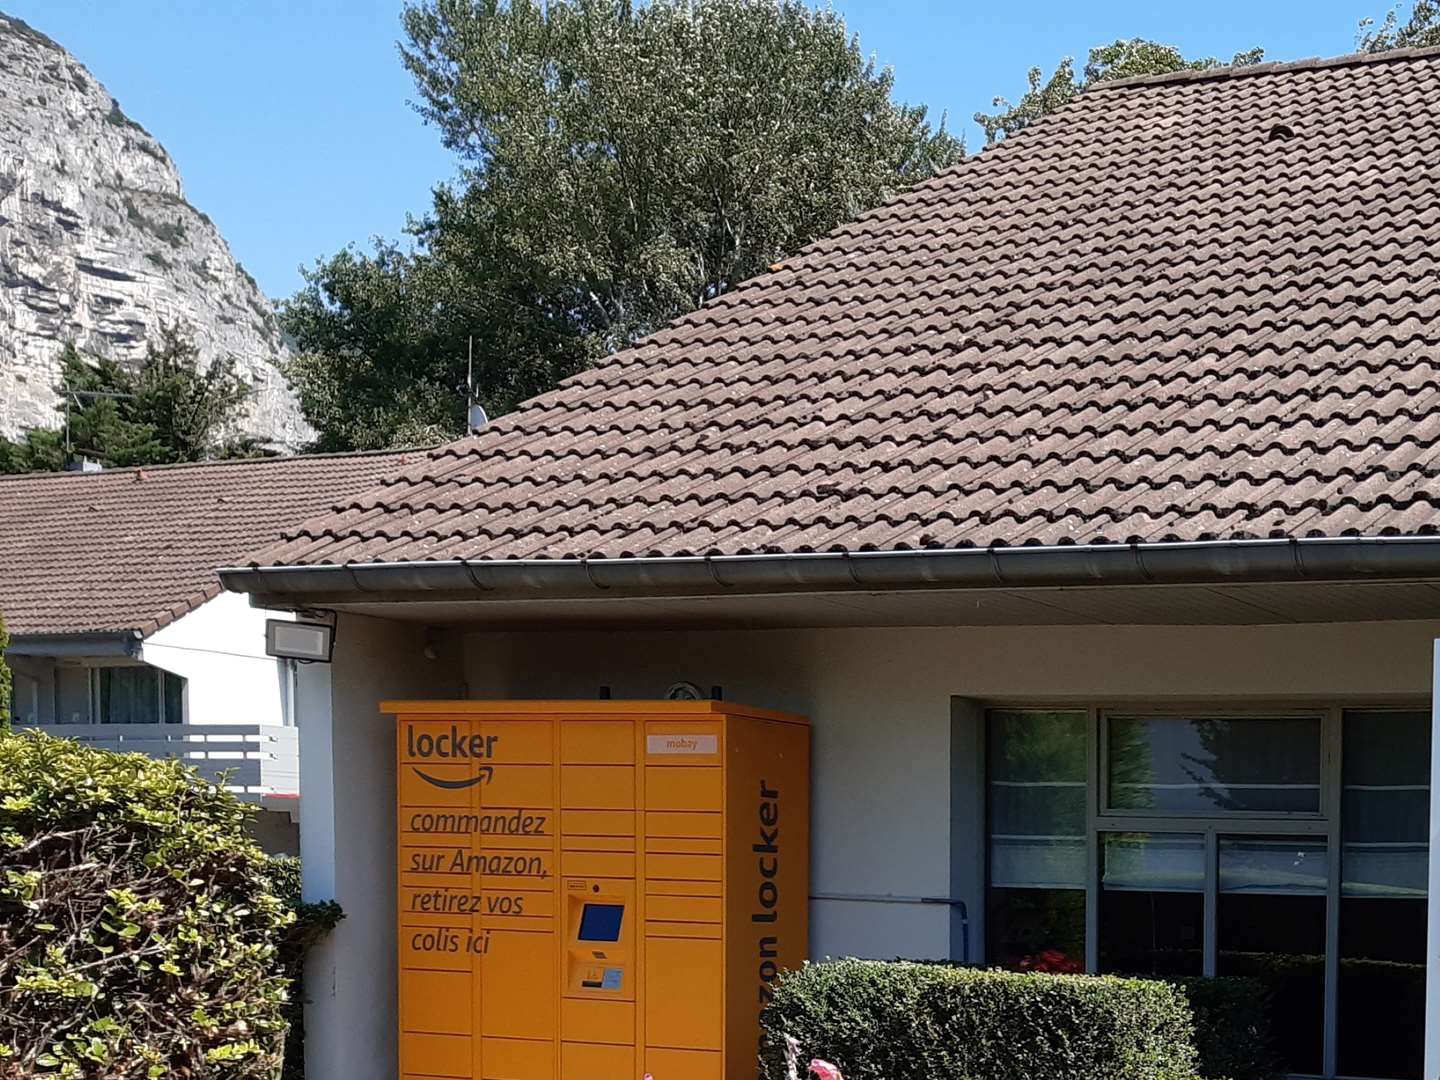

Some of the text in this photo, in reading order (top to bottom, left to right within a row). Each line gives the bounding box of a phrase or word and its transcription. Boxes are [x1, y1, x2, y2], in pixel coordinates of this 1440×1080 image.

[408, 724, 498, 758] locker
[411, 808, 546, 834] commandez
[411, 850, 547, 879] sur Amazon,
[752, 779, 780, 923] locker
[411, 889, 523, 914] retirez vos
[411, 927, 491, 954] colis ici
